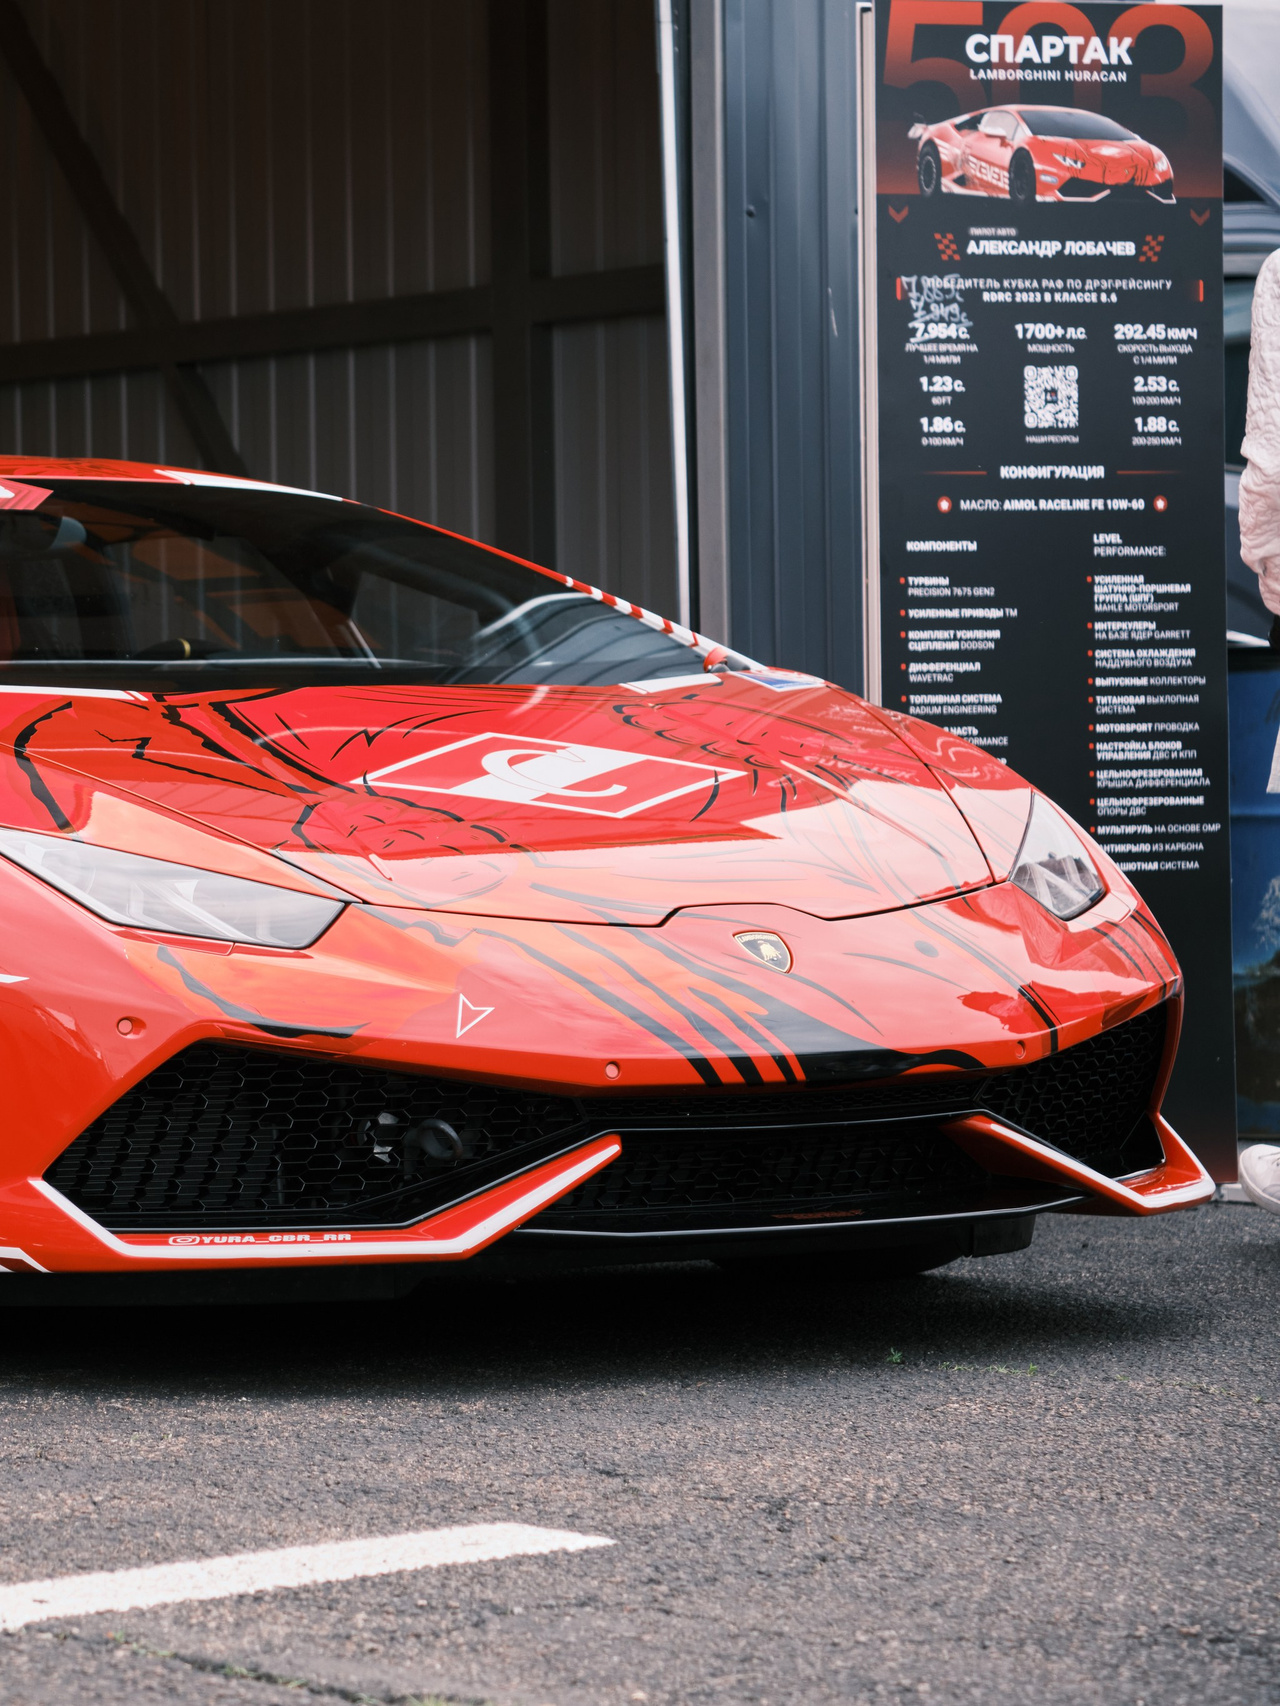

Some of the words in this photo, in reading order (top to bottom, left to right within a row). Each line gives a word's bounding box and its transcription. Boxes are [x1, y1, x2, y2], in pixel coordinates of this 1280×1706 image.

[965, 33, 1133, 65] СПАРТАК
[970, 68, 1061, 81] LAMBORGHINI
[1065, 69, 1127, 83] HURACAN
[966, 239, 1062, 258] АЛЕКСАНДР
[1064, 241, 1136, 256] ЛОБАЧЕВ
[1003, 278, 1039, 289] КУБКА
[1041, 278, 1064, 289] РАФ
[1067, 278, 1082, 289] ПО
[982, 292, 1012, 302] RDRC
[1015, 292, 1041, 302] 2023
[1054, 292, 1098, 302] КЛАССЕ
[1014, 323, 1064, 339] 1700+
[1114, 323, 1166, 340] 292.45
[1027, 343, 1075, 353] МОЩНОСТЬ
[1117, 344, 1158, 353] СКОРОСТЬ
[1159, 343, 1193, 353] ВЫХОДА
[919, 375, 953, 392] 1.23
[1133, 375, 1167, 392] 2.53
[920, 416, 953, 433] 1.86
[1134, 416, 1167, 432] 1.88
[1000, 465, 1104, 480] КОНФИГУРАЦИЯ
[960, 500, 1002, 511] МАСЛО:
[1003, 499, 1037, 511] AIMOL
[1039, 499, 1090, 510] RACELINE
[1091, 499, 1104, 510] FE
[1106, 499, 1145, 510] 10W-60
[1093, 533, 1122, 544] LEVEL
[906, 541, 977, 551] КОМПОНЕНТЫ
[907, 576, 949, 586] ТУРБИНЫ
[1094, 574, 1144, 584] УСИЛЕННАЯ
[908, 587, 950, 597] PRECISION
[1094, 583, 1191, 593] ШАТУННО-ПОРШНЕВАЯ
[1094, 593, 1128, 603] ГРУППА
[1094, 602, 1122, 612] MAHLE
[1124, 602, 1179, 612] MOTORSPORT
[908, 608, 960, 619] УСИЛЕННЫЕ
[961, 608, 1003, 619] ПРИВОДЫ
[1094, 621, 1156, 630] ИНТЕРКУЛЕРЫ
[908, 630, 954, 640] КОМПЛЕКТ
[956, 629, 1000, 639] УСИЛЕНИЯ
[1095, 630, 1107, 639] НА
[1108, 630, 1129, 639] БАЗЕ
[1154, 630, 1190, 639] GARRETT
[908, 641, 959, 652] СЦЕПЛЕНИЯ
[960, 640, 995, 650] DODSON
[1095, 649, 1135, 658] СИСТЕМА
[1136, 648, 1196, 658] ОХЛАЖДЕНИЯ
[908, 662, 981, 673] ДИФФЕРЕНЦИАЛ
[1095, 658, 1152, 668] НАДДУВНОГО
[1153, 658, 1192, 668] ВОЗДУХА
[909, 673, 953, 683] WAVETRAC
[1095, 677, 1148, 687] ВЫПУСКНЫЕ
[1150, 676, 1206, 685] КОЛЛЕКТОРЫ
[909, 694, 960, 704] ТОПЛИВНАЯ
[961, 694, 1002, 703] СИСТЕМА
[1096, 695, 1145, 705] ТИТАНОВАЯ
[1146, 694, 1199, 704] ВЫХЛОПНАЯ
[909, 705, 942, 715] RADIUM
[943, 705, 997, 714] ENGINEERING
[1096, 705, 1136, 714] СИСТЕМА
[1096, 723, 1153, 733] MOTORSPORT
[1154, 722, 1199, 732] ПРОВОДКА
[1096, 740, 1147, 750] НАСТРОЙКА
[1148, 741, 1182, 750] БЛОКОВ
[1096, 750, 1151, 760] УПРАВЛЕНИЯ
[1152, 750, 1170, 760] ДВС
[1171, 750, 1177, 759] И
[1179, 750, 1197, 759] КПП
[1096, 768, 1202, 779] ЦЕЛЬНОФРЕЗЕРОВАННАЯ
[1097, 779, 1134, 788] КРЫШКА
[1135, 777, 1210, 788] ДИФФЕРЕНЦИАЛА
[1097, 796, 1204, 807] ЦЕЛЬНОФРЕЗЕРОВАННЫЕ
[1097, 807, 1128, 816] ОПОРЫ
[1129, 807, 1146, 816] ДВС
[1097, 824, 1153, 835] МУЛЬТИРУЛЬ
[1154, 824, 1166, 833] НА
[1167, 824, 1201, 833] ОСНОВЕ
[1165, 842, 1204, 851] КАРБОНА
[1160, 860, 1200, 870] СИСТЕМА
